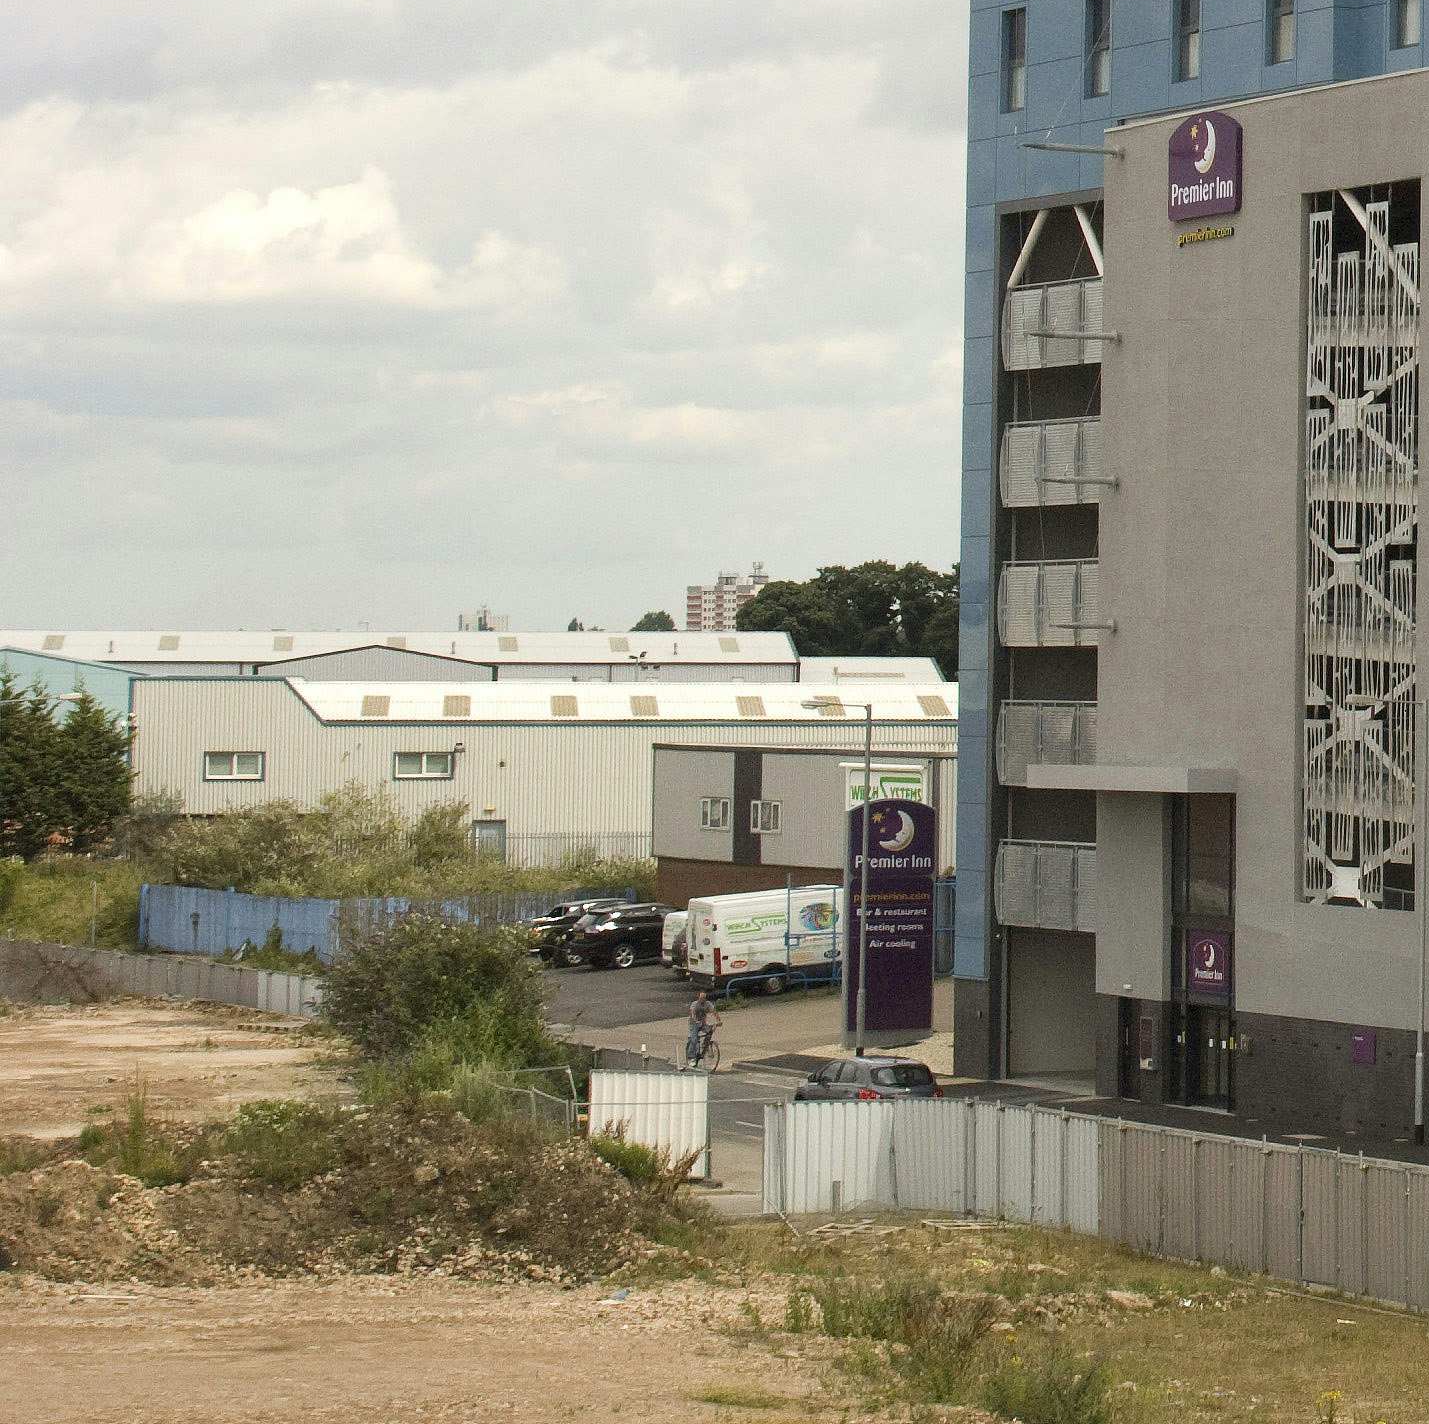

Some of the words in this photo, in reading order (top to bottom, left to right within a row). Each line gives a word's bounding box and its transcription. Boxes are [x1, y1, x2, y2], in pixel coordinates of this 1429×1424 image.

[1171, 178, 1215, 207] Premier
[1216, 176, 1234, 198] Inn
[912, 854, 932, 868] Inn
[856, 908, 872, 916] Br
[874, 908, 882, 916] &
[884, 908, 927, 916] restaurant
[869, 940, 883, 948] Air
[886, 939, 916, 949] cooling
